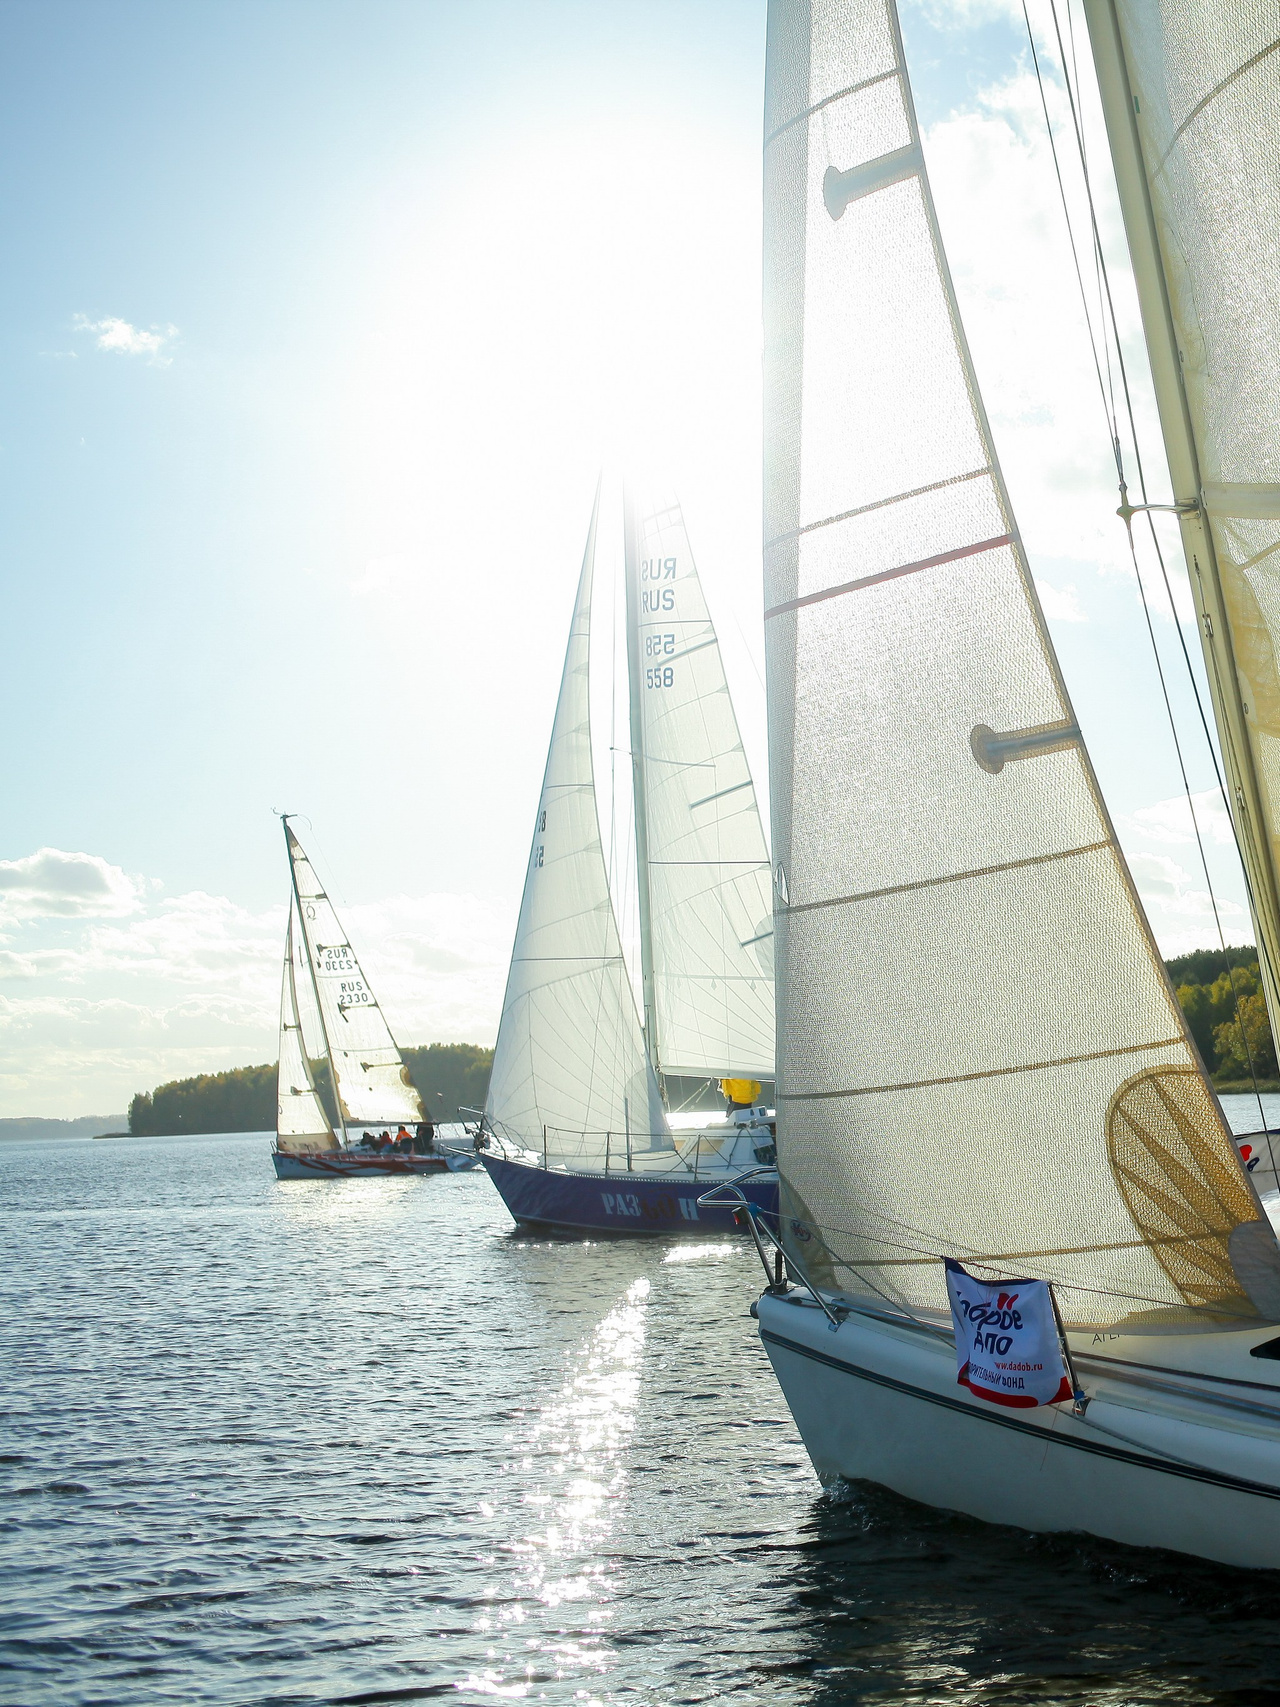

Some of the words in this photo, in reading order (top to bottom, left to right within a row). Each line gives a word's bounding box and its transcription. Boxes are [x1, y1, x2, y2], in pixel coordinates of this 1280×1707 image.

[642, 589, 675, 614] RUS
[646, 667, 674, 690] 558
[340, 981, 363, 993] RUS
[339, 993, 368, 1005] 2330
[1002, 1376, 1025, 1390] ФОНД
